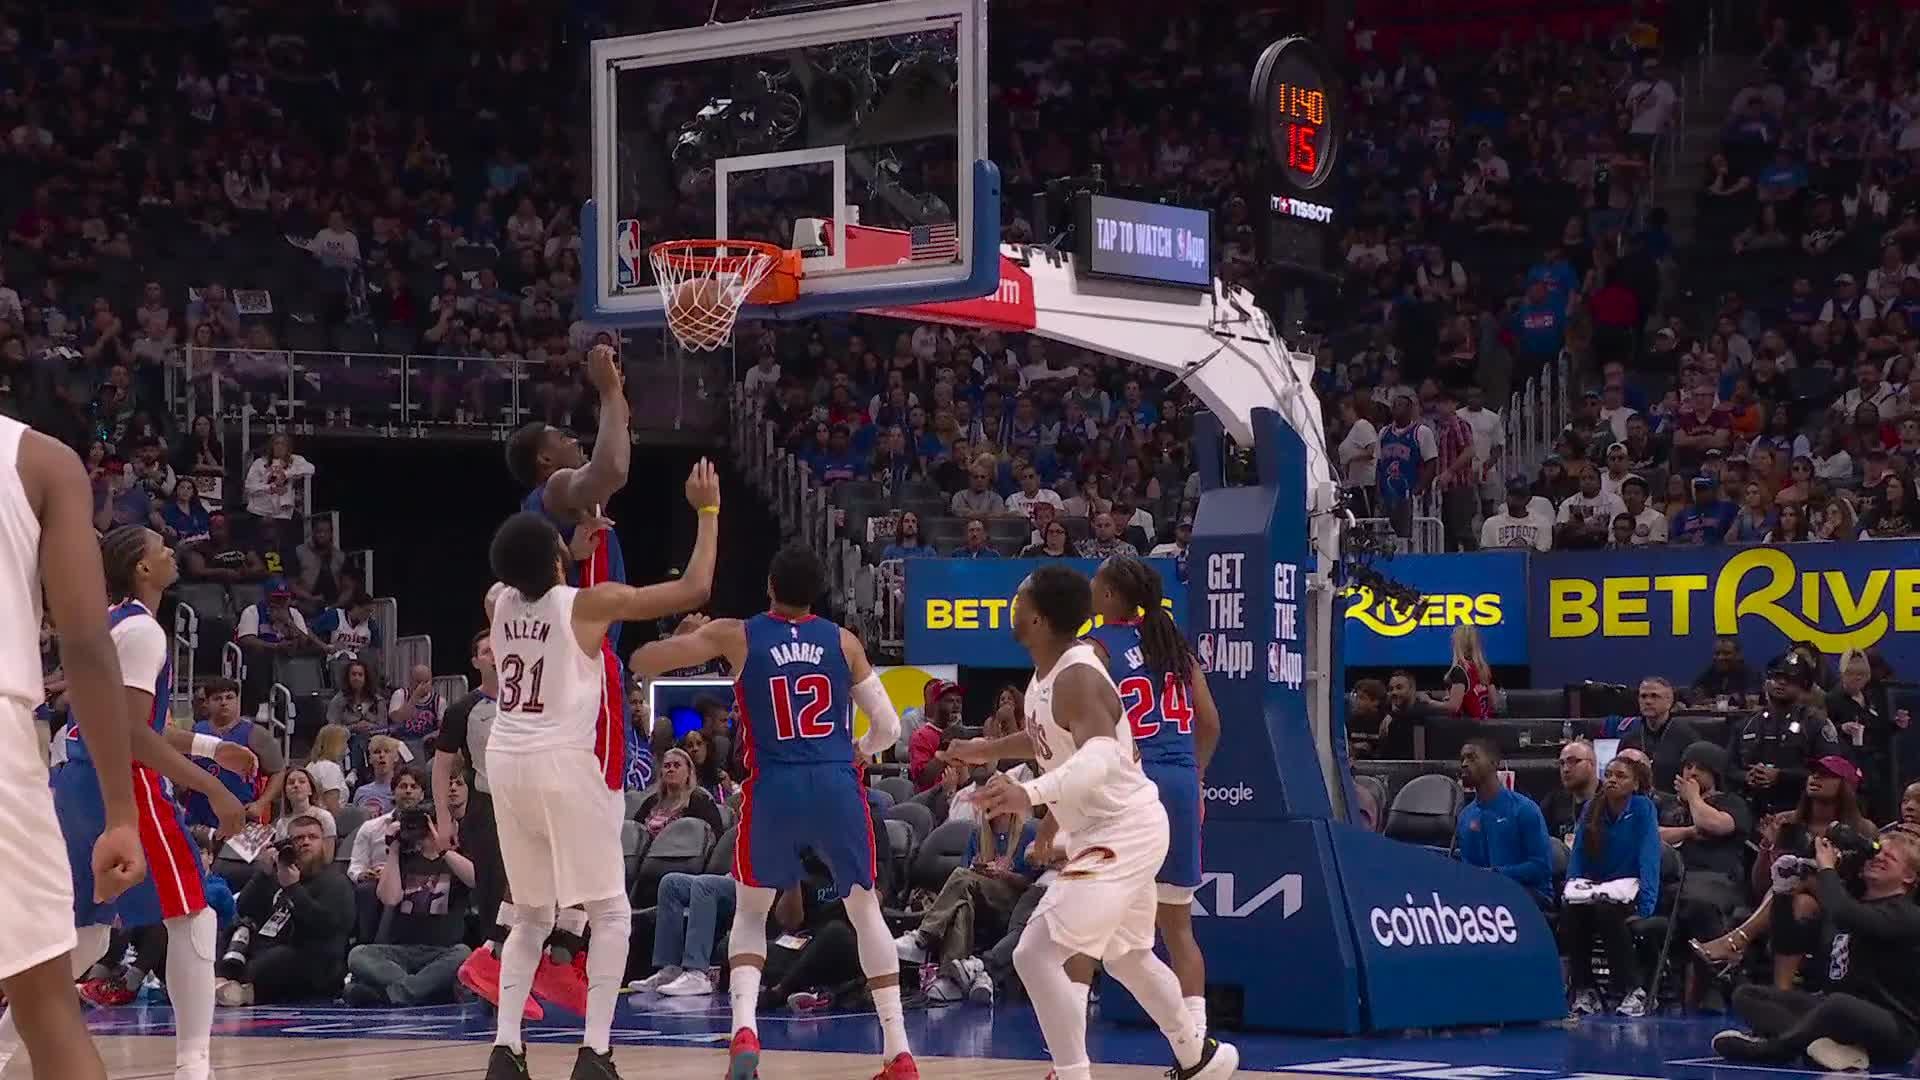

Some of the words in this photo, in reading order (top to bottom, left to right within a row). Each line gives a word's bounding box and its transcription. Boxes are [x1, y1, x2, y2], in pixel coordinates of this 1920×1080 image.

[1280, 84, 1323, 125] 11:40
[1288, 123, 1317, 173] 15
[1288, 198, 1333, 223] TISSOT
[1096, 218, 1118, 251] TAP
[1120, 221, 1134, 253] TO
[1136, 224, 1172, 258] WATCH
[1186, 230, 1205, 268] App
[1498, 525, 1538, 544] DETROIT
[1208, 553, 1244, 590] GET
[1275, 562, 1297, 600] GET
[504, 620, 550, 643] ALLEN
[1207, 593, 1244, 629] THE
[1274, 602, 1297, 640] THE
[770, 642, 824, 667] HARRIS
[1215, 634, 1253, 679] App
[1279, 644, 1302, 690] App
[500, 653, 545, 713] 31
[769, 673, 834, 741] 12
[1119, 672, 1194, 739] 24
[1370, 892, 1517, 947] coinbase
